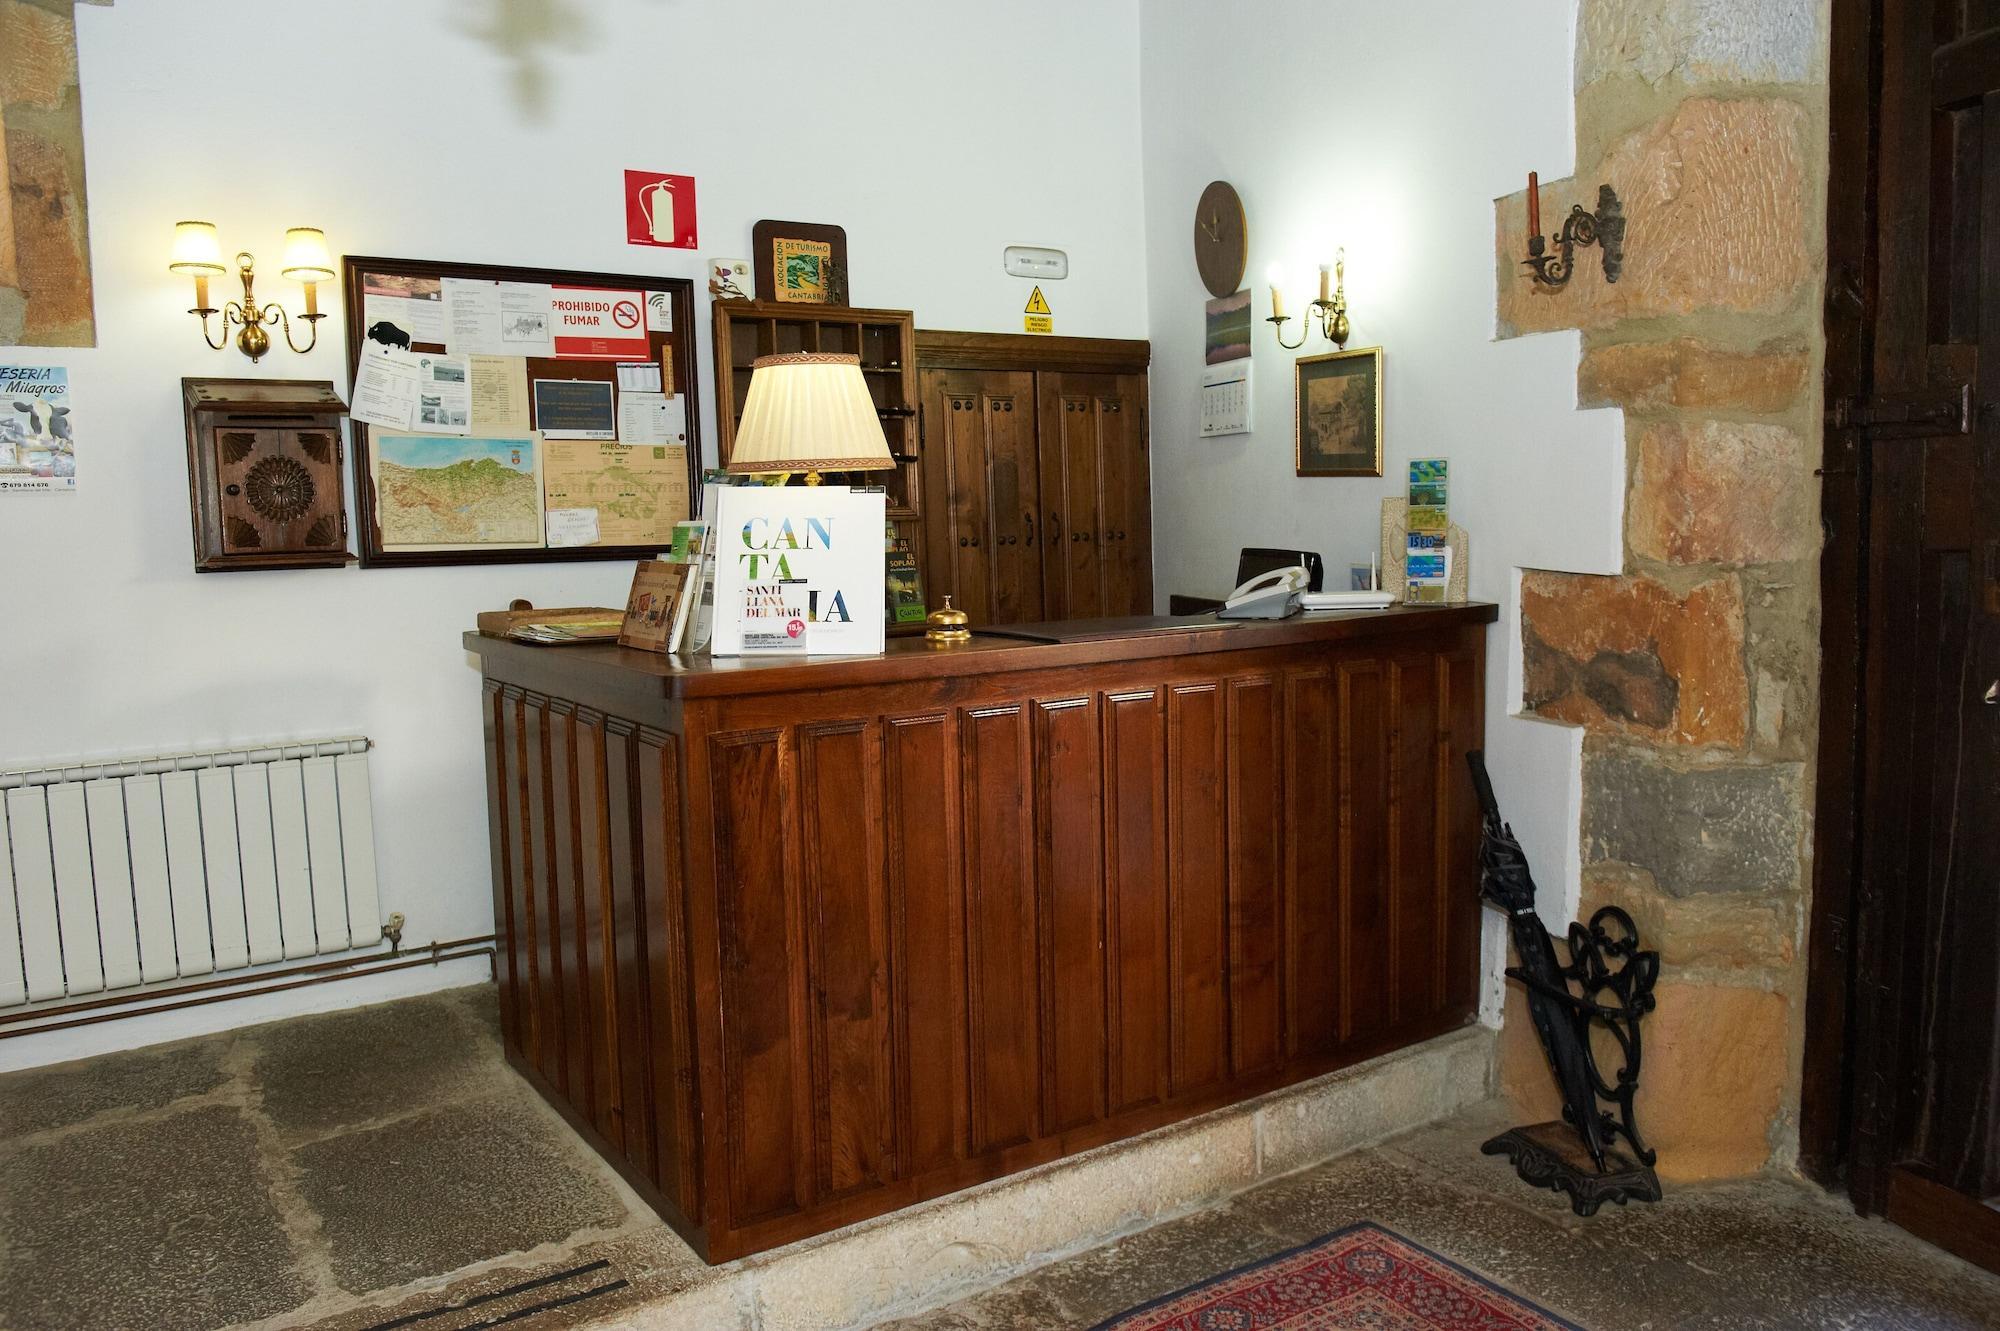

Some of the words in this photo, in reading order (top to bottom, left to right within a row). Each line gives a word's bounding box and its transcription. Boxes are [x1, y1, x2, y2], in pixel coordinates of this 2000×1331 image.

[796, 244, 828, 252] TURISMO
[553, 301, 610, 312] PROHIBIDO
[564, 315, 600, 326] FUMAR
[0, 367, 51, 380] ESERIA
[5, 380, 66, 398] Milagros
[889, 560, 915, 568] SOPLAO
[747, 585, 782, 595] SANTI
[747, 597, 784, 606] LLANA
[747, 608, 770, 617] DEL
[776, 608, 801, 617] MAR
